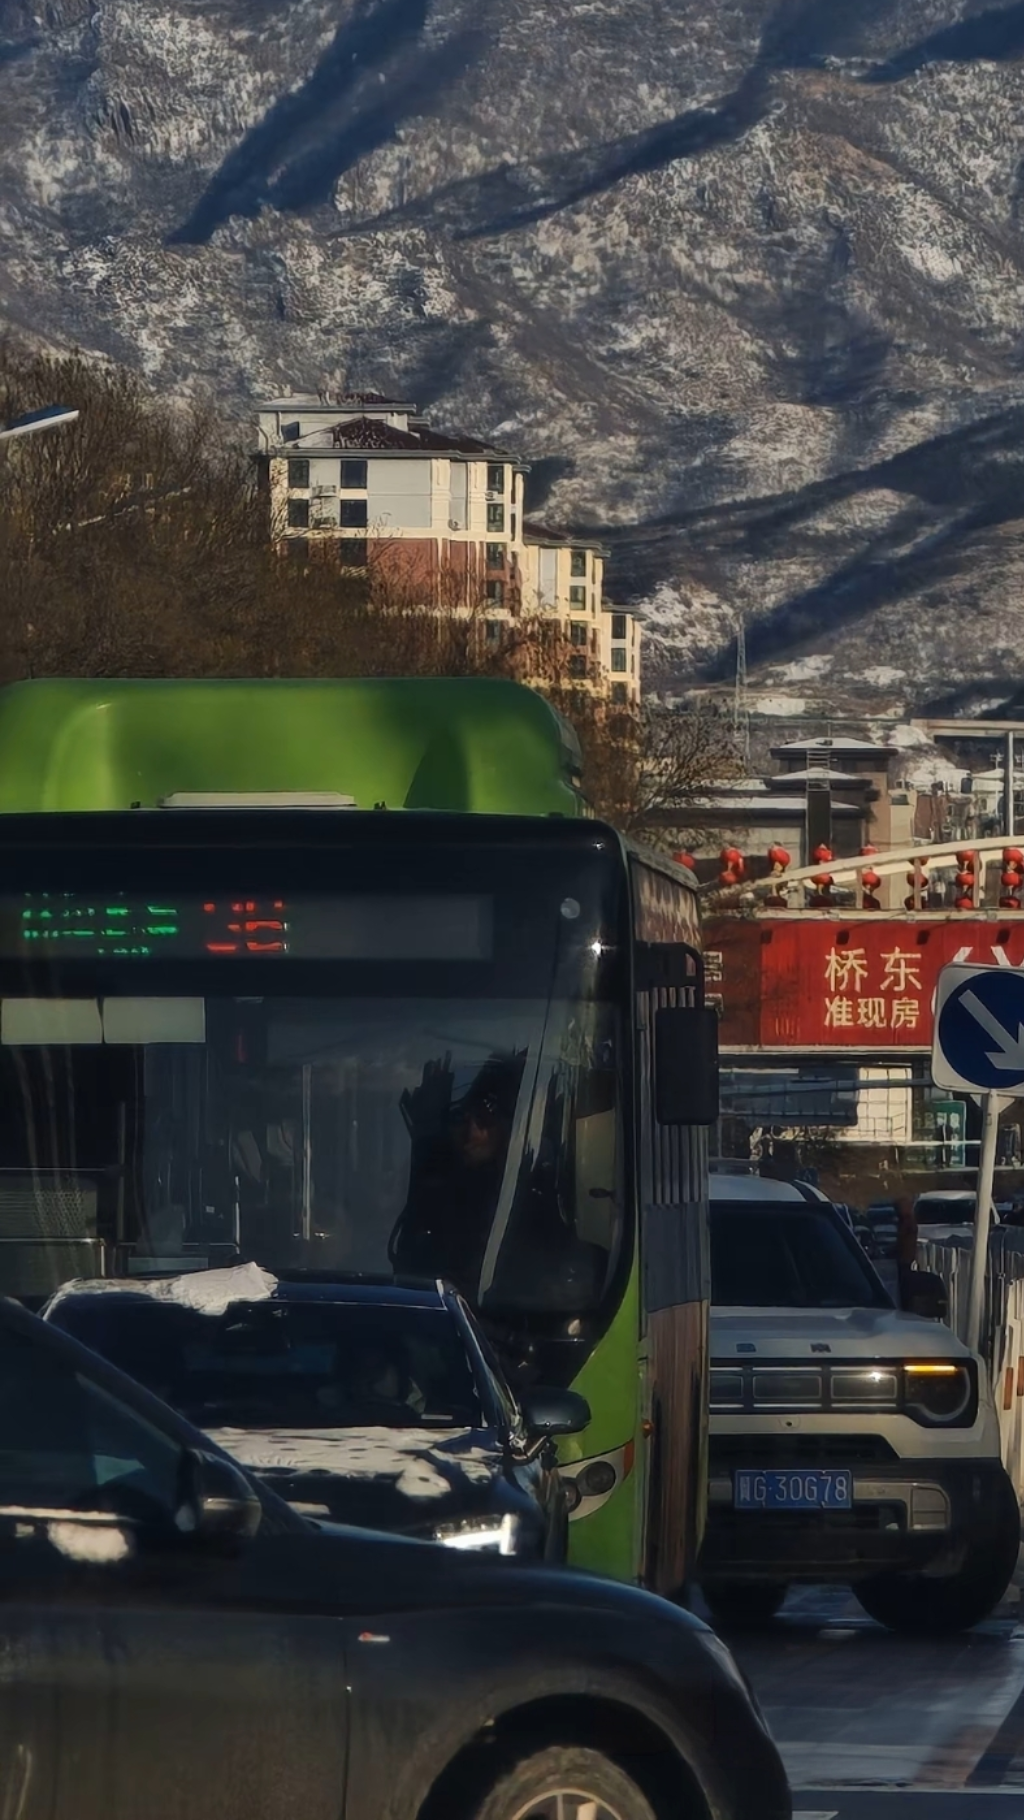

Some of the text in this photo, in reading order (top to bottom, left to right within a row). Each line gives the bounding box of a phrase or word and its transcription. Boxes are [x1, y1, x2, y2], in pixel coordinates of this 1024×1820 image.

[824, 946, 922, 992] 桥东
[824, 997, 920, 1028] 准现房
